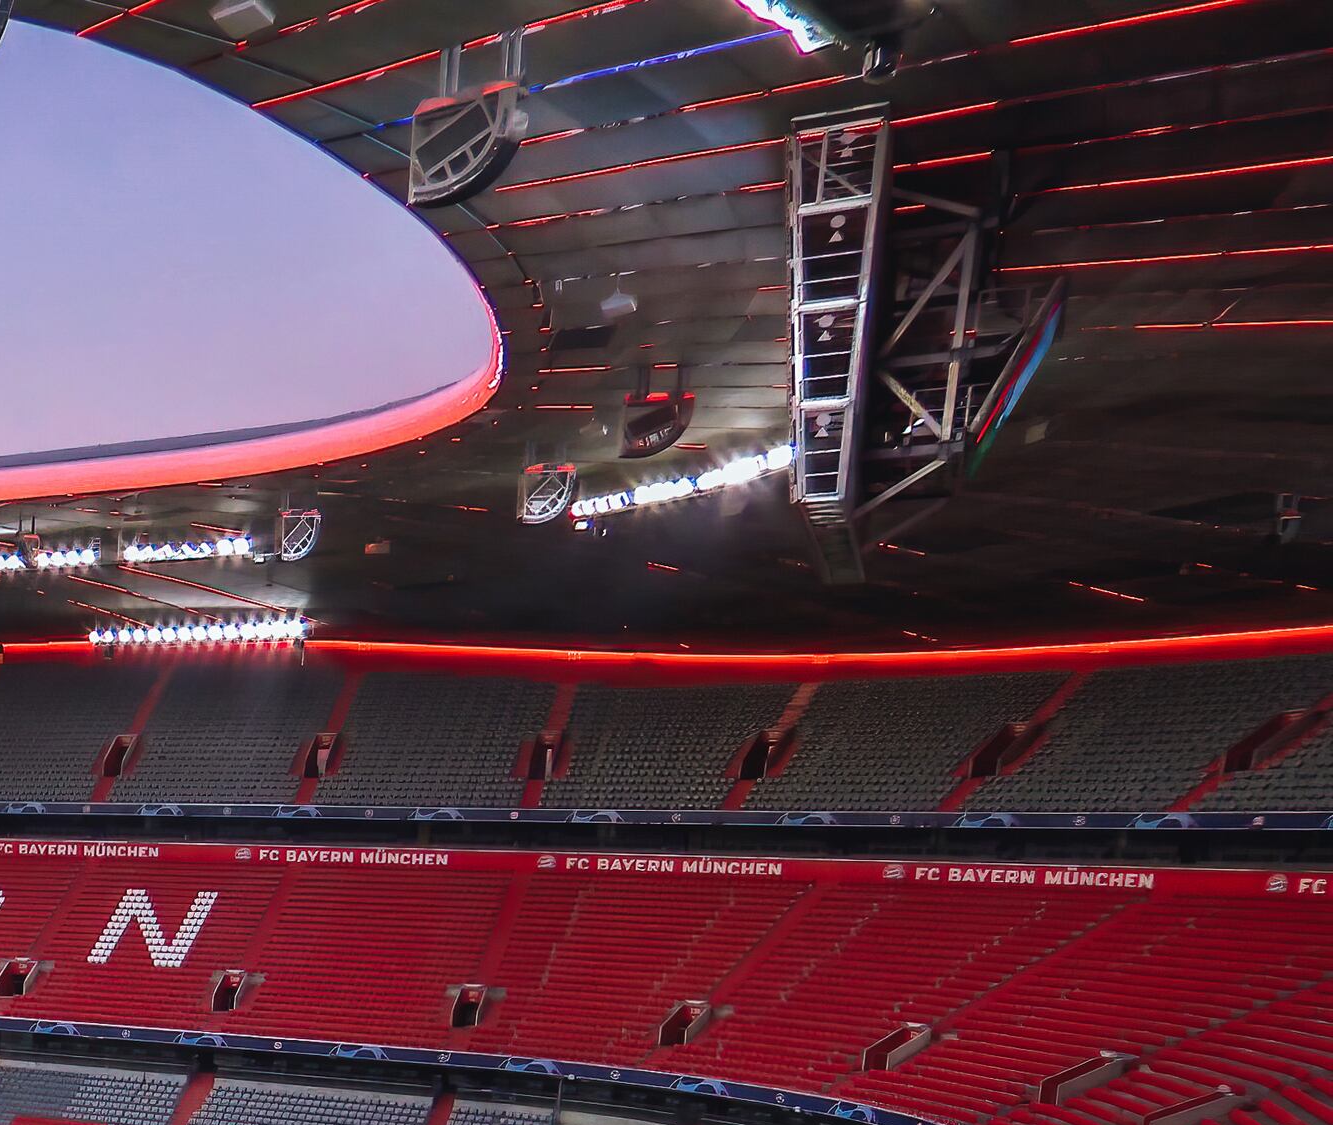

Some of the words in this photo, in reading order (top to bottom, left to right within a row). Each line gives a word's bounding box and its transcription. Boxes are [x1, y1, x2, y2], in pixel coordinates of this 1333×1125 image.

[18, 843, 78, 855] BAYERN
[83, 842, 159, 858] MÜNCHEN
[259, 849, 280, 861] FC
[286, 849, 354, 863] BAYERN
[360, 848, 448, 865] MÜNCHEN
[565, 857, 589, 870] FC
[597, 857, 675, 872] BAYERN
[682, 856, 782, 876] MÜNCHEN
[915, 867, 941, 881] FC
[948, 867, 1036, 885] BAYERN
[1044, 867, 1155, 889] MÜNCHEN
[1298, 878, 1327, 894] FC
